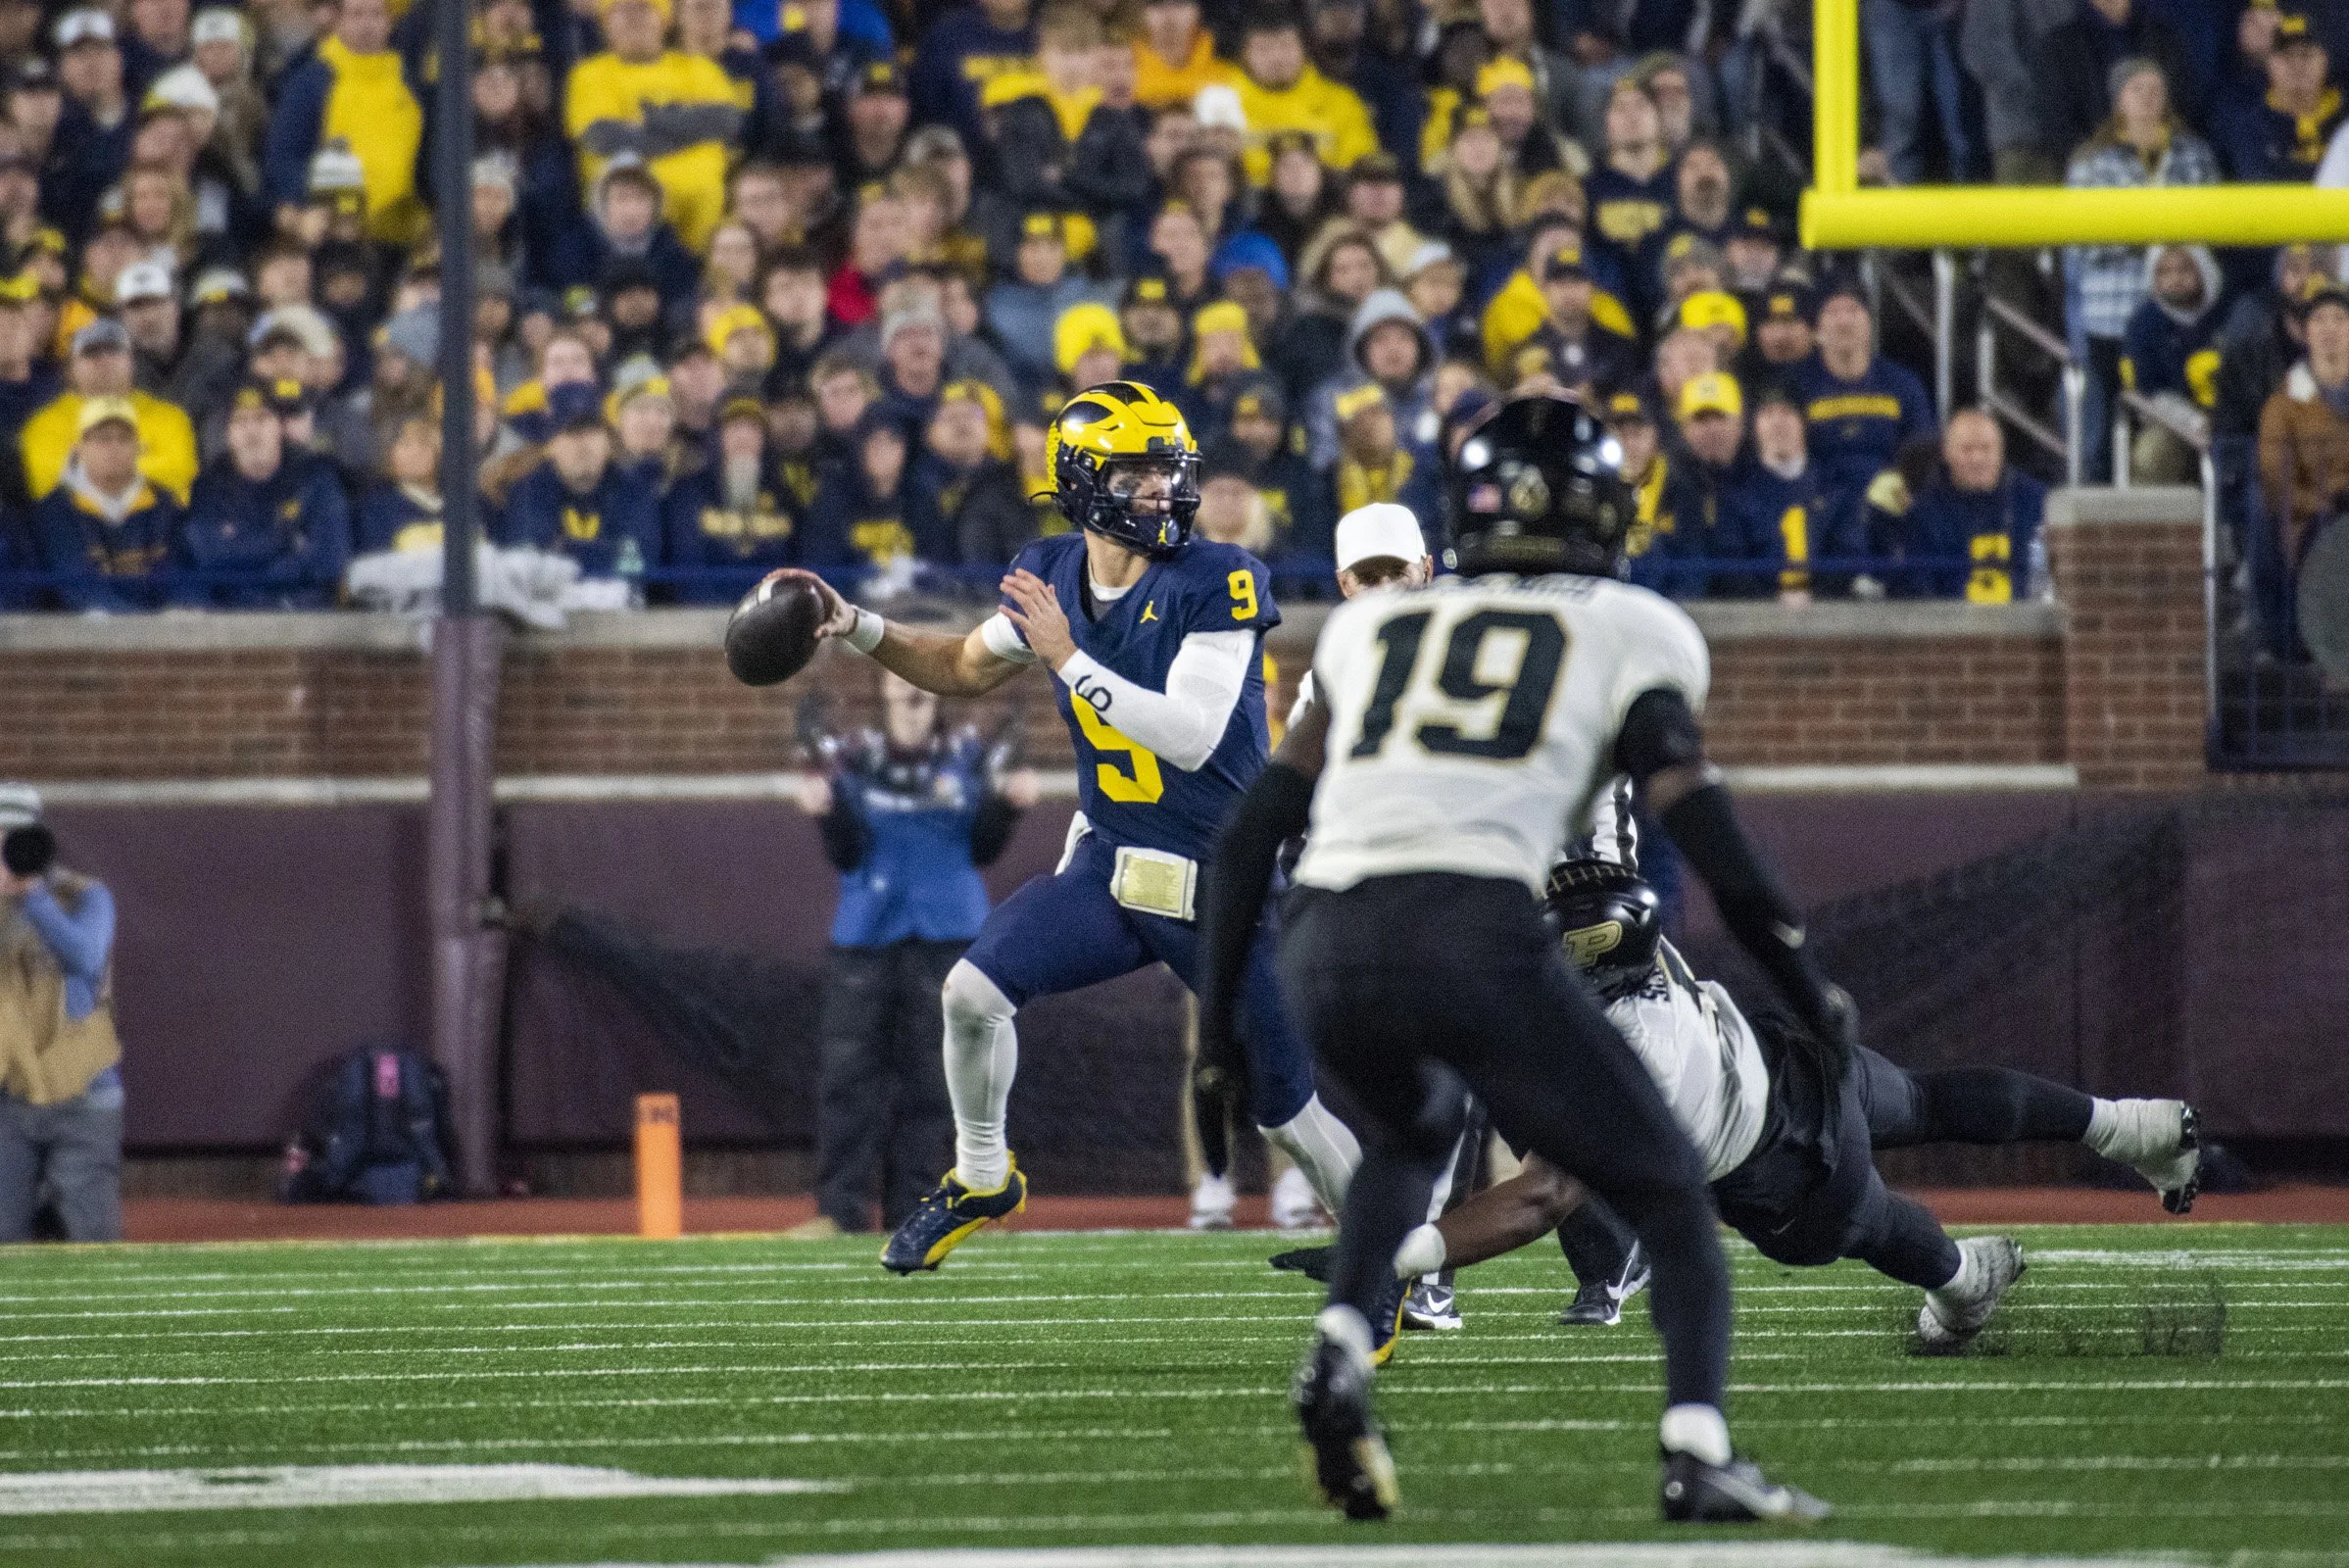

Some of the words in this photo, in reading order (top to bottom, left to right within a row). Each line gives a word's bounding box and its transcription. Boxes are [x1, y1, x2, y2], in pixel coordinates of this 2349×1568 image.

[1228, 569, 1259, 621] 9
[1347, 608, 1571, 762] 19
[1563, 919, 1623, 967] P
